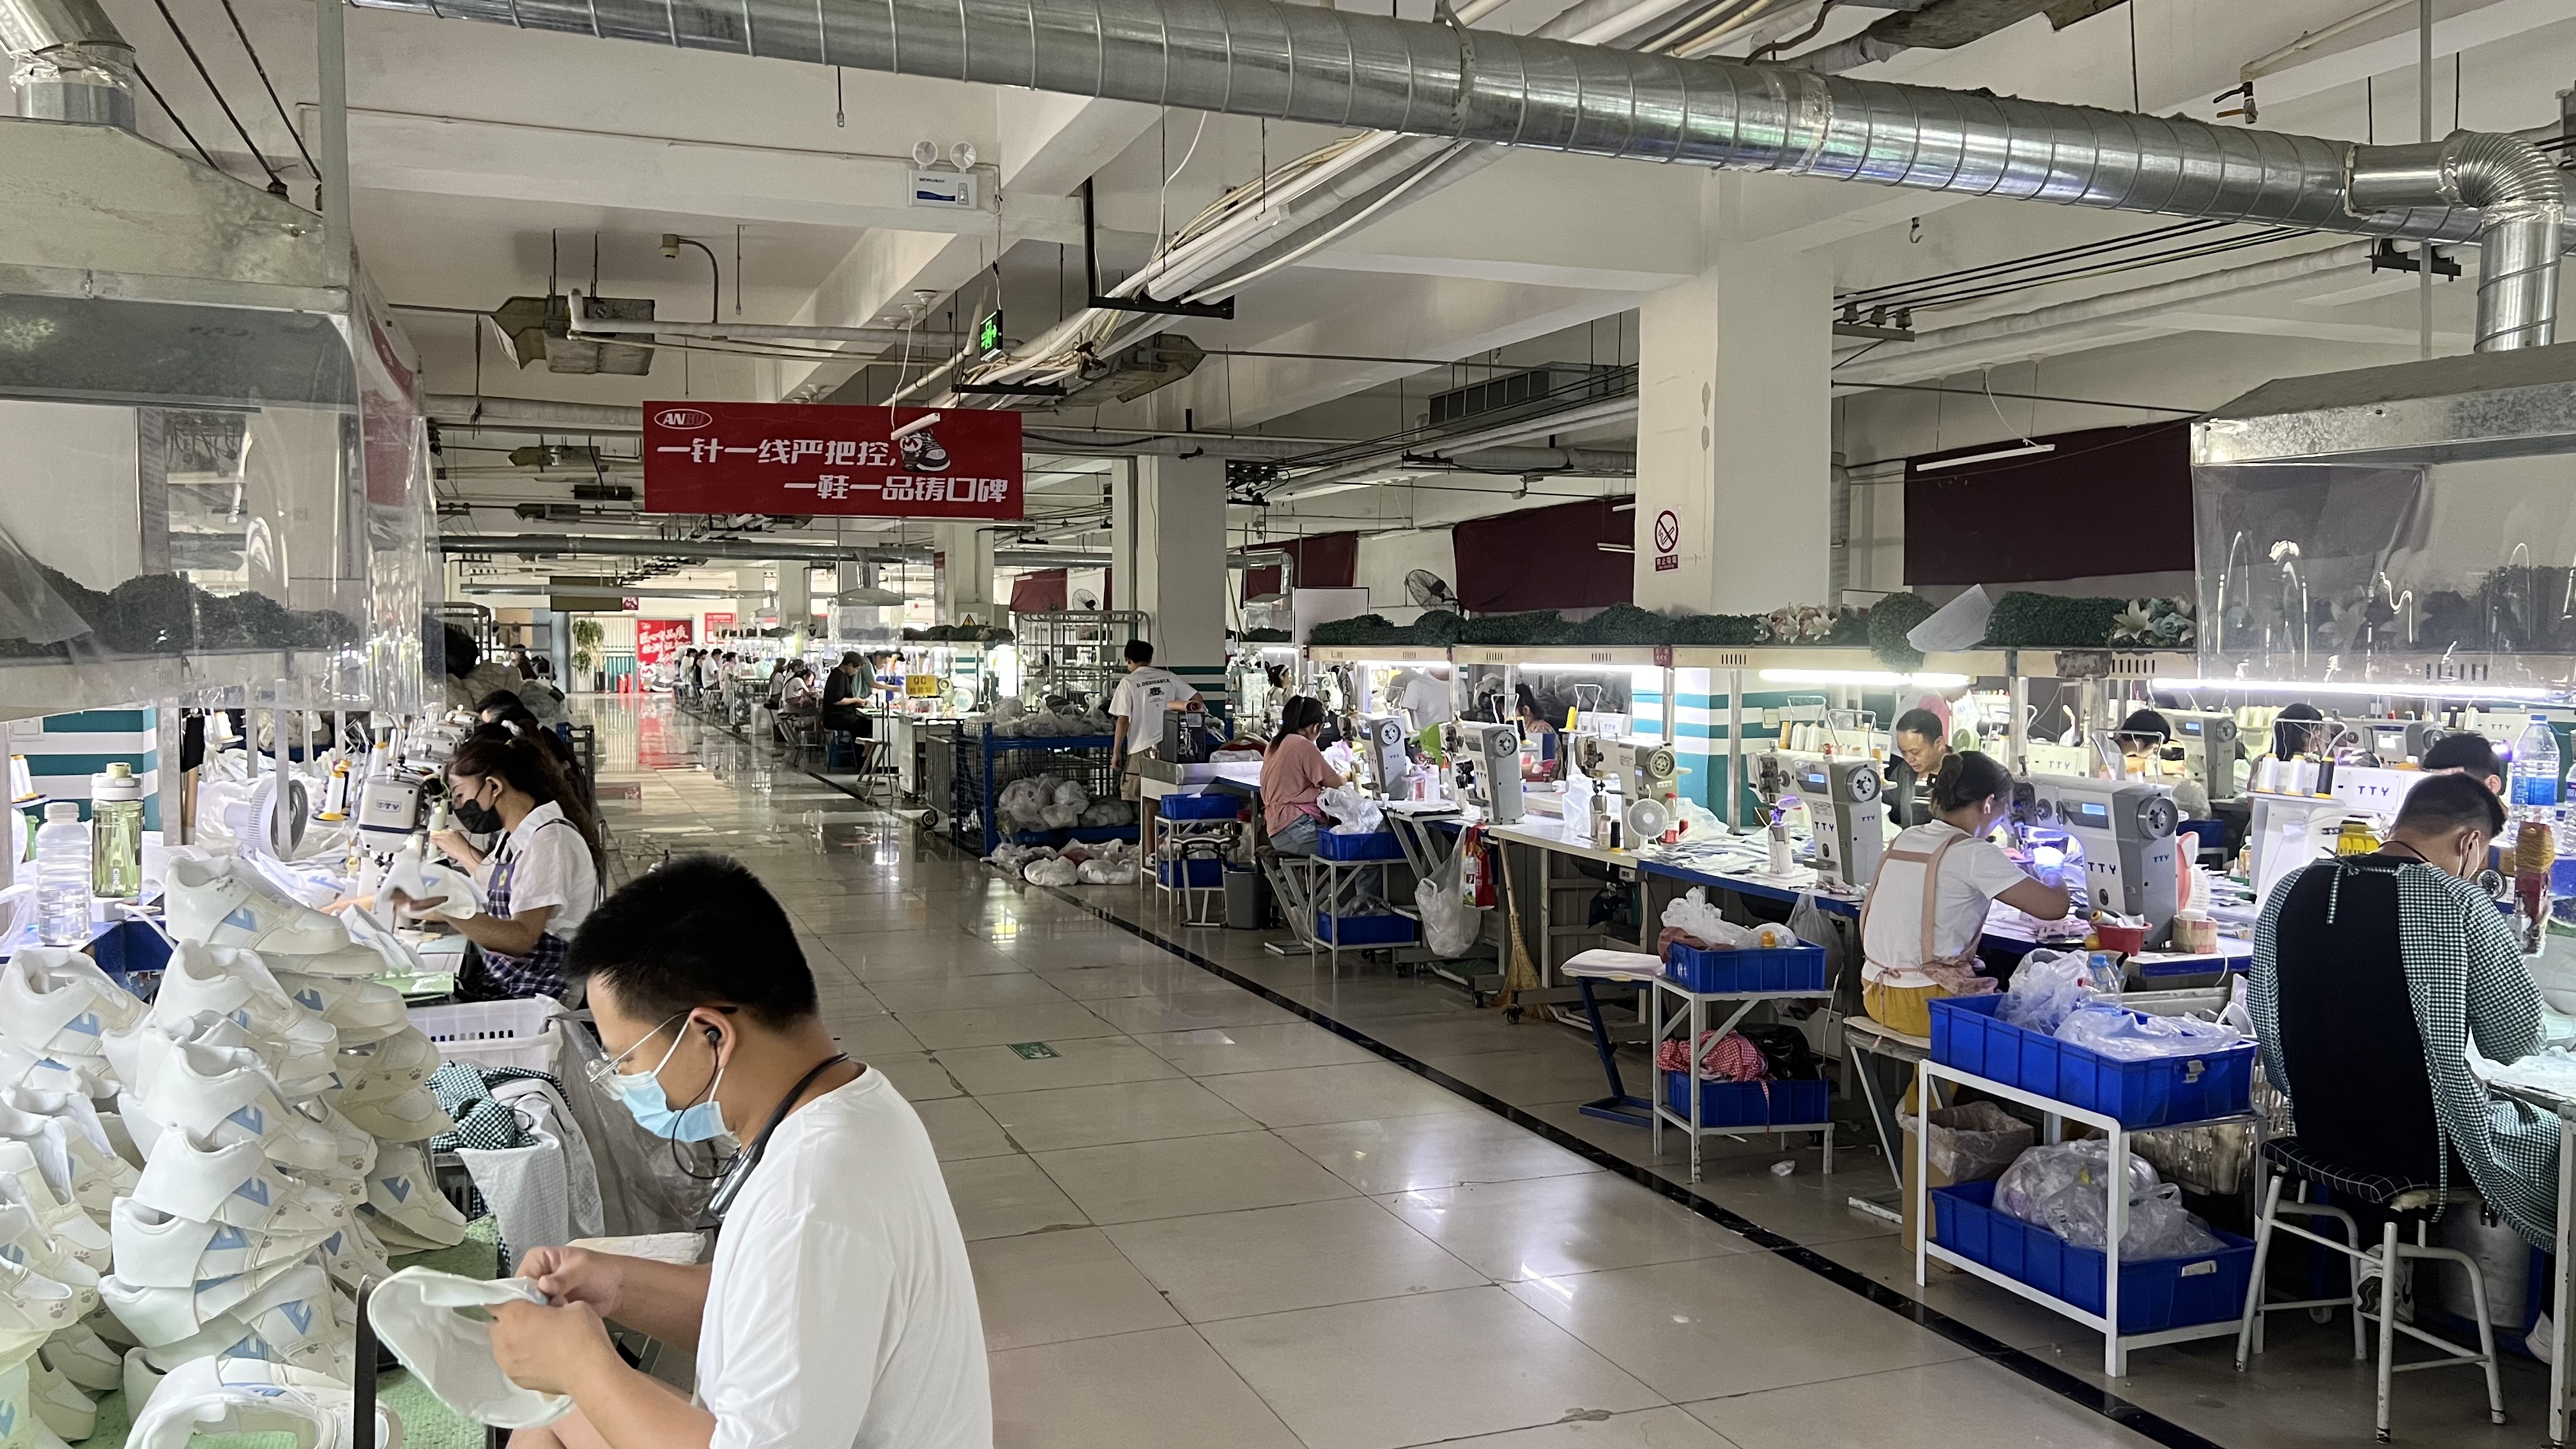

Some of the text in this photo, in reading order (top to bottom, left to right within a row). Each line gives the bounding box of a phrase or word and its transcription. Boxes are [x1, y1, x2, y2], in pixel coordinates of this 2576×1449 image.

[784, 475, 1008, 503] 一鞋一品铸口碑
[914, 676, 927, 685] QC
[2048, 760, 2071, 770] TTY
[2358, 785, 2389, 797] TTY
[1814, 821, 1834, 832] TTY
[2153, 854, 2170, 863] TTY
[2087, 861, 2117, 875] TTY
